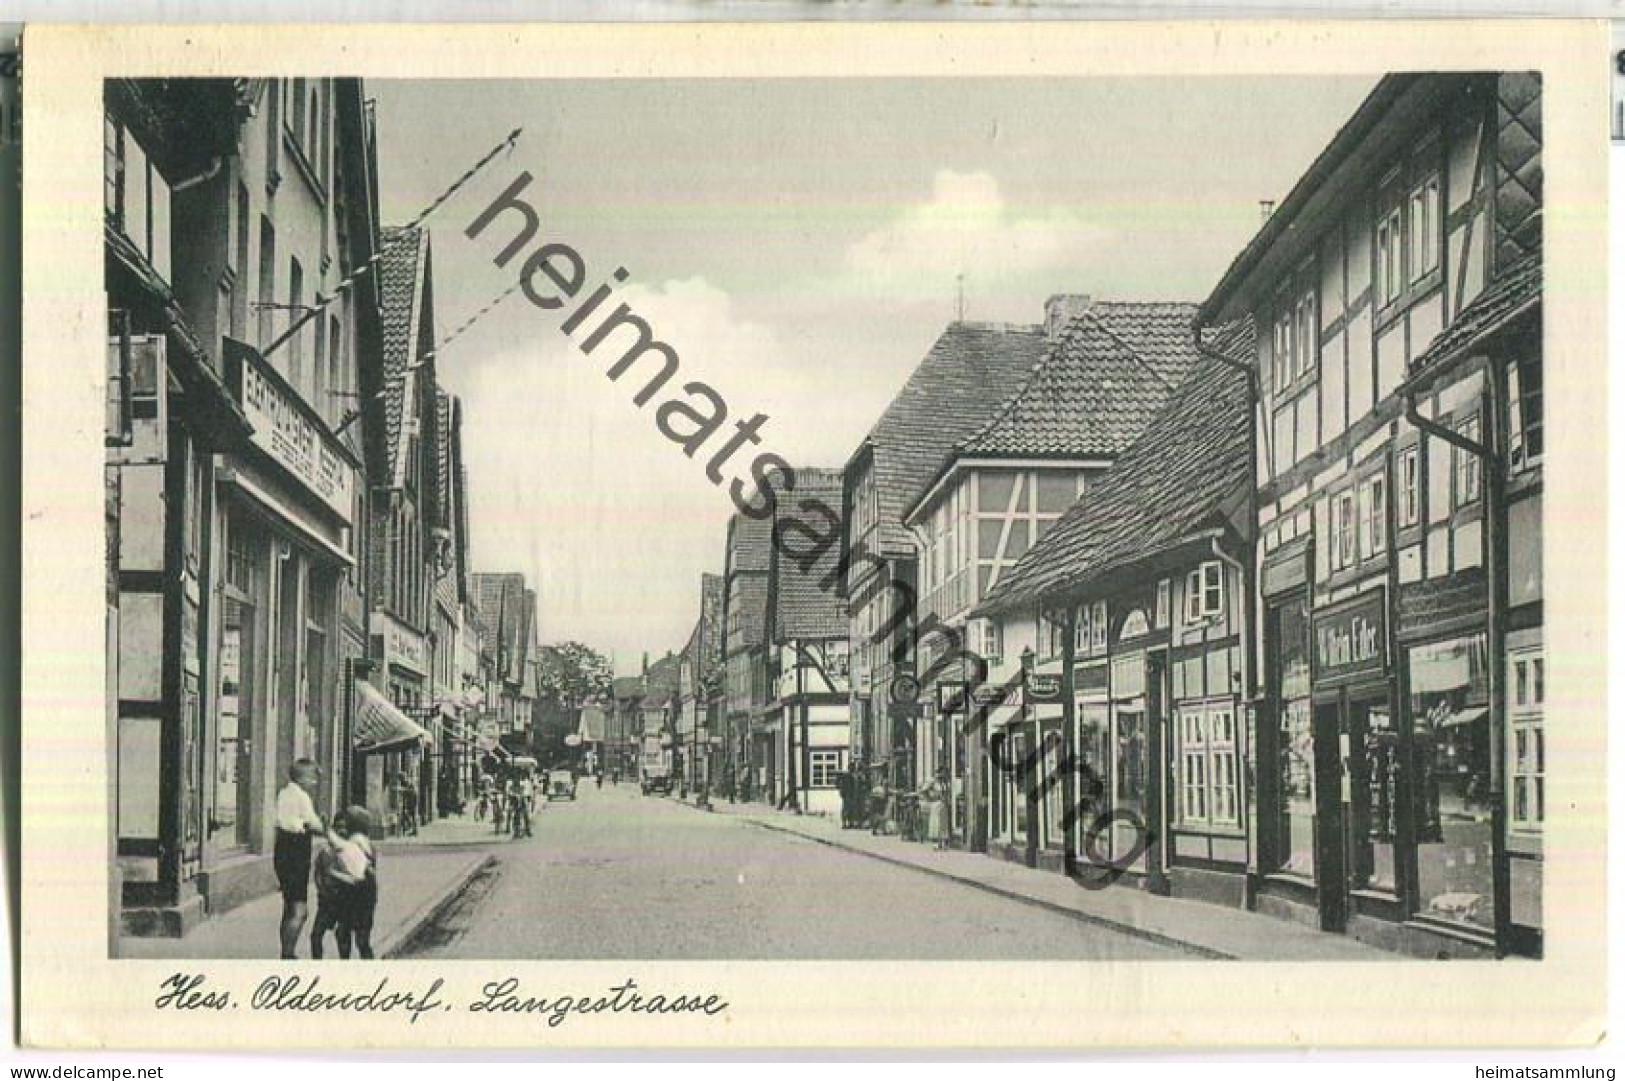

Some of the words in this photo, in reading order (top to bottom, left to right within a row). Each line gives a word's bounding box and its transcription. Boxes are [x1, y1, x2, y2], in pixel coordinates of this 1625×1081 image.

[156, 973, 238, 1010] Hess.
[251, 976, 452, 1023] Oldendorf.
[469, 978, 727, 1028] Langestrasse
